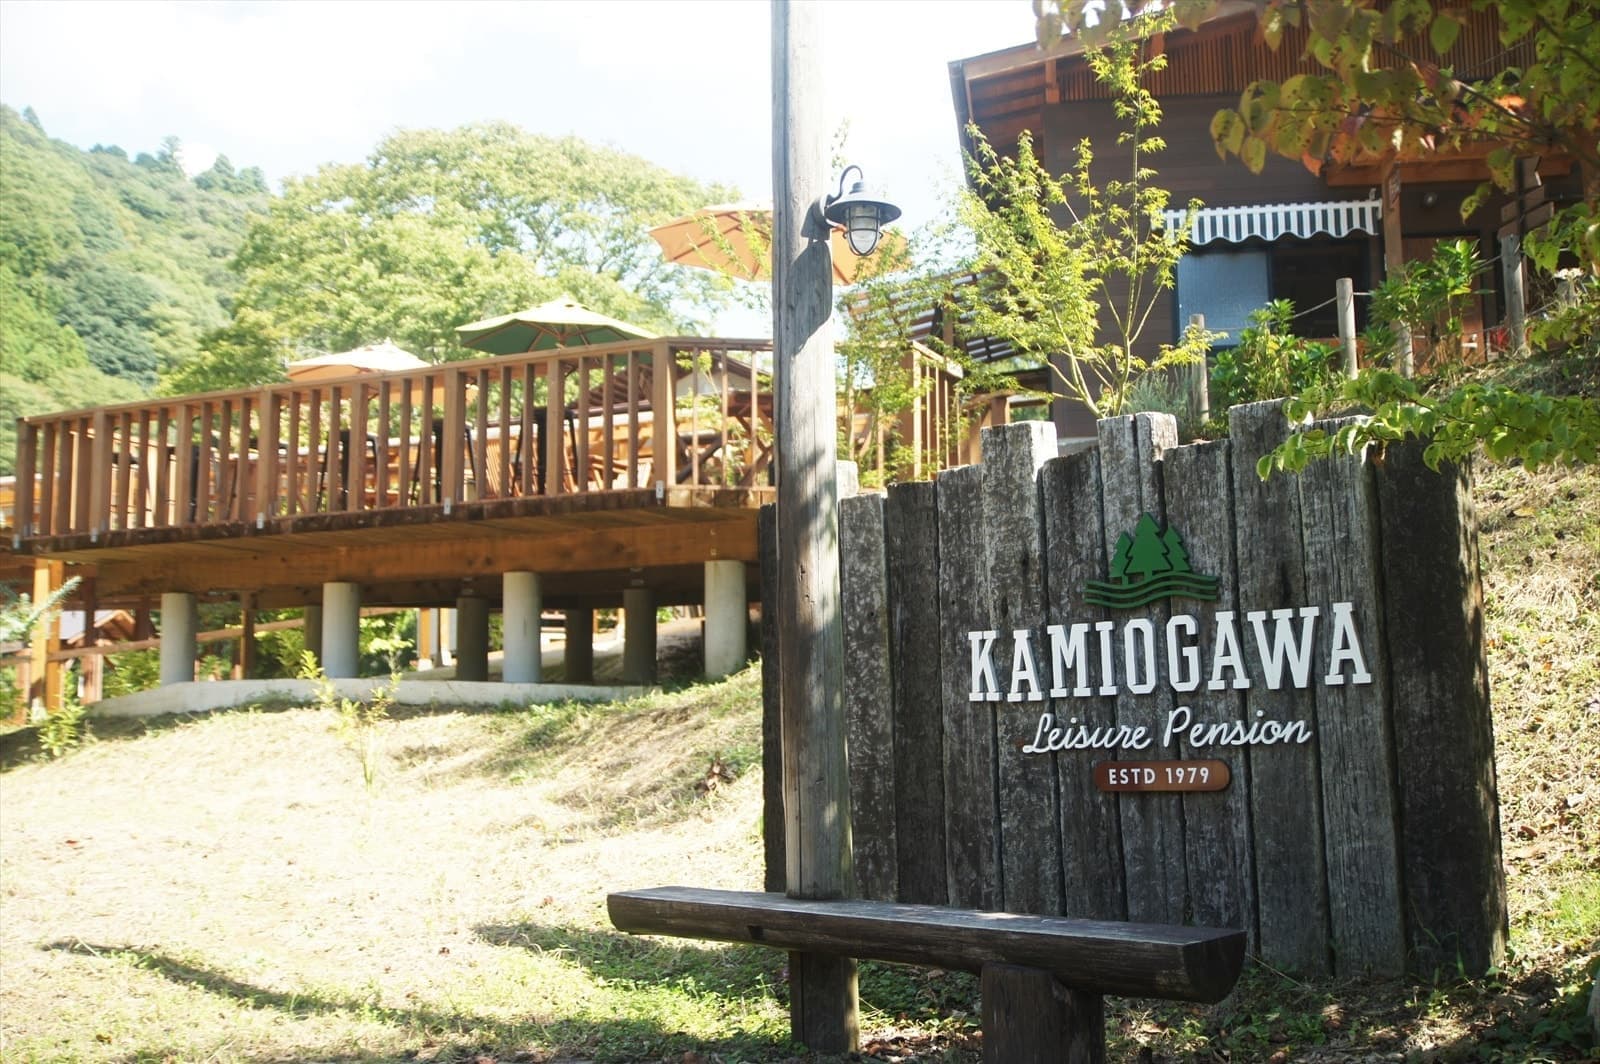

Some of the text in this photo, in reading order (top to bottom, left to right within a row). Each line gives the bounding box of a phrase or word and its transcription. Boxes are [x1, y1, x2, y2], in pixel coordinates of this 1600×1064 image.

[968, 602, 1372, 702] KAMIOGAWA
[1022, 706, 1312, 754] Leisure Pension
[1108, 767, 1210, 786] ESTD 1979
